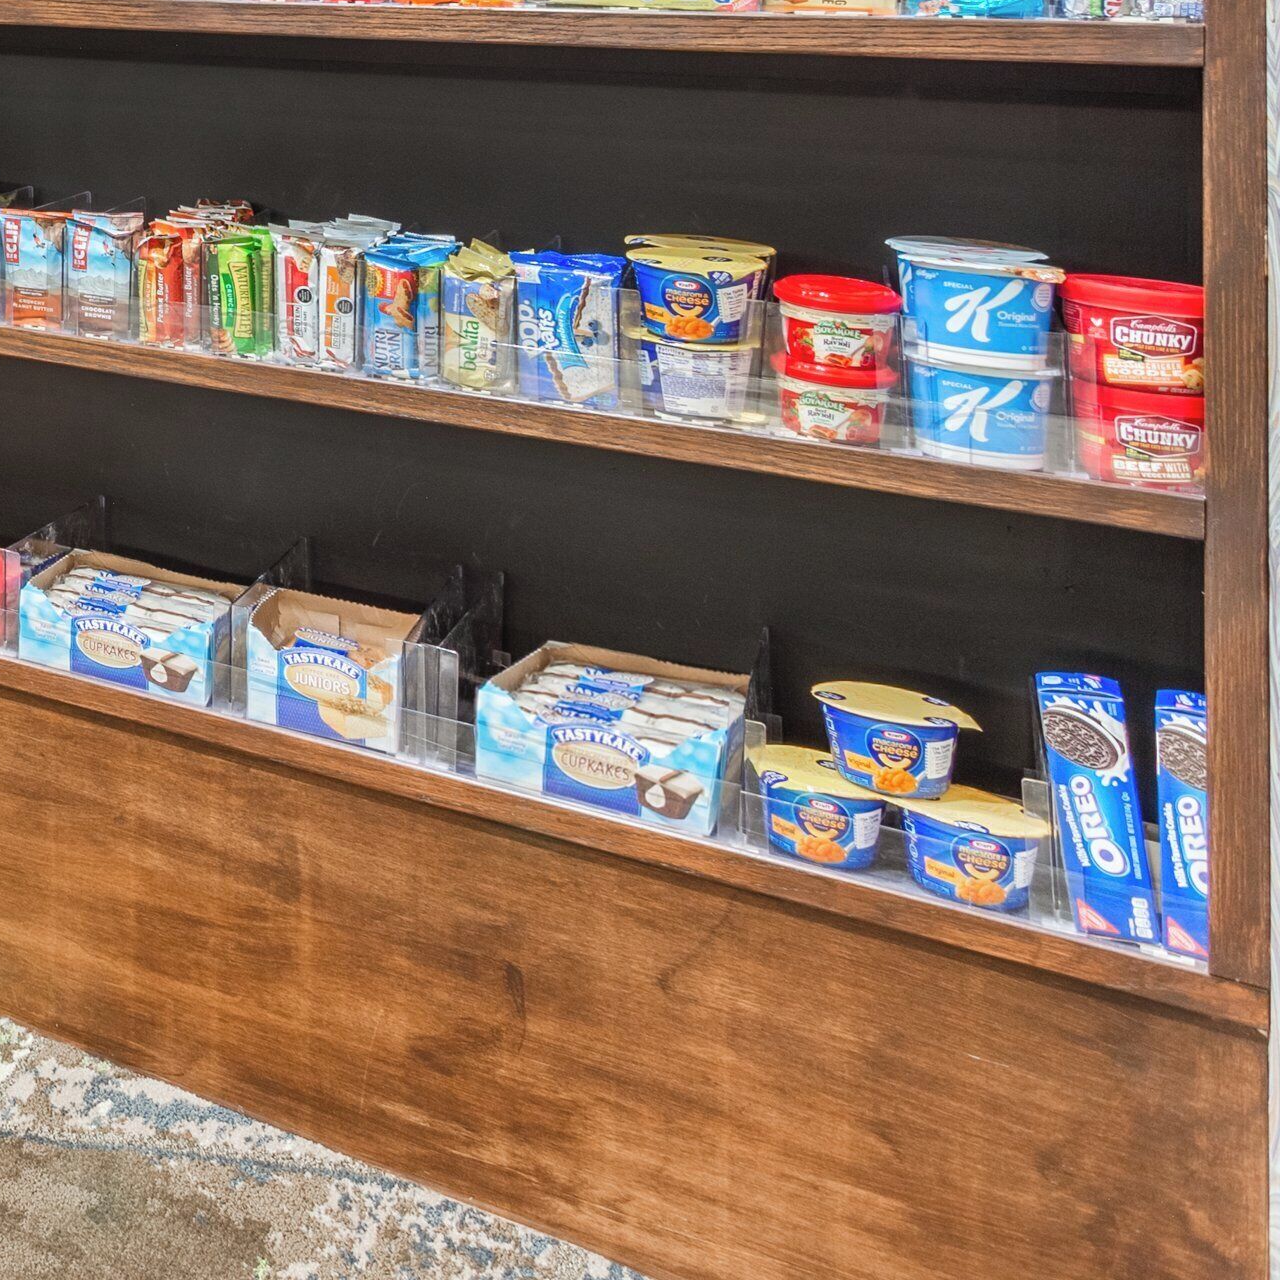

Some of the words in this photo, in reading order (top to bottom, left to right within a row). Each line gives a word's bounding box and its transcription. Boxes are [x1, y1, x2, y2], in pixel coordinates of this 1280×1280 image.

[4, 220, 20, 253] CLIF
[73, 225, 90, 260] CLIF
[156, 273, 164, 294] Butter
[234, 266, 249, 297] NATURE
[943, 282, 974, 290] SPECIAL
[18, 298, 46, 306] CRUNCHY
[81, 306, 116, 314] CHOCOLATE
[665, 293, 710, 307] Cheese
[944, 280, 1026, 342] K
[84, 312, 112, 320] BROWNIE
[237, 299, 252, 336] VALLEY
[997, 311, 1037, 322] Original
[1130, 318, 1177, 333] Campbell's
[373, 327, 387, 371] NUTRI
[459, 320, 480, 372] belVita
[823, 339, 851, 348] Ravioli
[1115, 326, 1192, 350] CHUNKY
[388, 330, 402, 370] GRAIN
[1107, 367, 1182, 378] NOODLE
[942, 380, 973, 390] SPECIAL
[807, 410, 834, 420] Ravioli
[943, 380, 1024, 442] K
[996, 412, 1035, 423] Original
[1119, 425, 1197, 449] CHUNKY
[1112, 460, 1163, 472] BEEF
[1167, 463, 1189, 473] WITH
[76, 619, 148, 647] TASTYKAKE
[82, 638, 137, 663] CUPKAKES
[283, 652, 361, 680] TASTYKAKE
[292, 673, 352, 695] JUNIORS
[552, 727, 646, 761] TASTYKAKE
[872, 744, 919, 759] Cheese
[560, 752, 631, 780] CUPKAKES
[798, 814, 845, 830] Cheese
[1069, 774, 1129, 877] OREO
[959, 855, 1007, 869] Cheese
